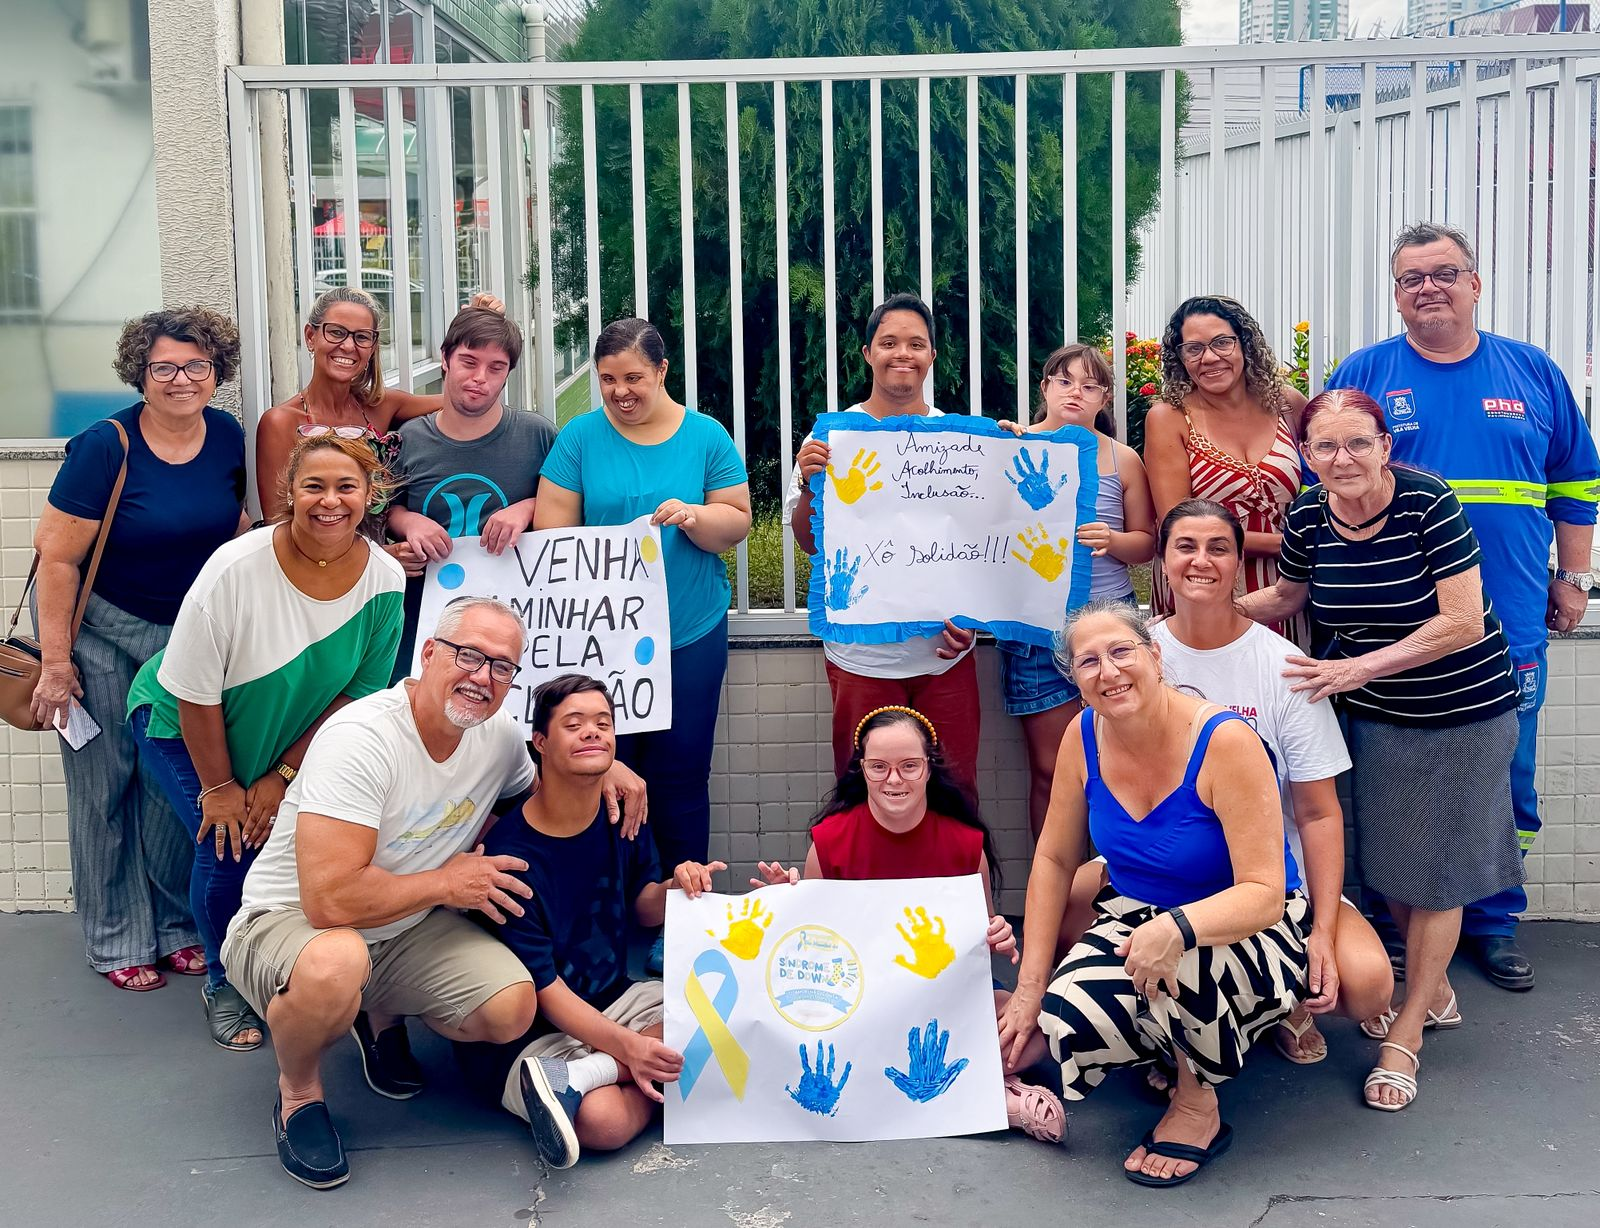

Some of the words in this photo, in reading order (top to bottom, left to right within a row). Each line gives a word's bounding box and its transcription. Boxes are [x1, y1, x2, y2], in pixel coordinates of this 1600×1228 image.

[897, 432, 985, 465] Amizade
[514, 536, 650, 587] VENHA
[863, 540, 896, 567] Xô
[523, 634, 604, 669] ELA
[1229, 705, 1258, 718] ELHA
[779, 955, 831, 974] SÍNDROME
[780, 967, 794, 980] DE
[798, 969, 831, 984] DOWN
